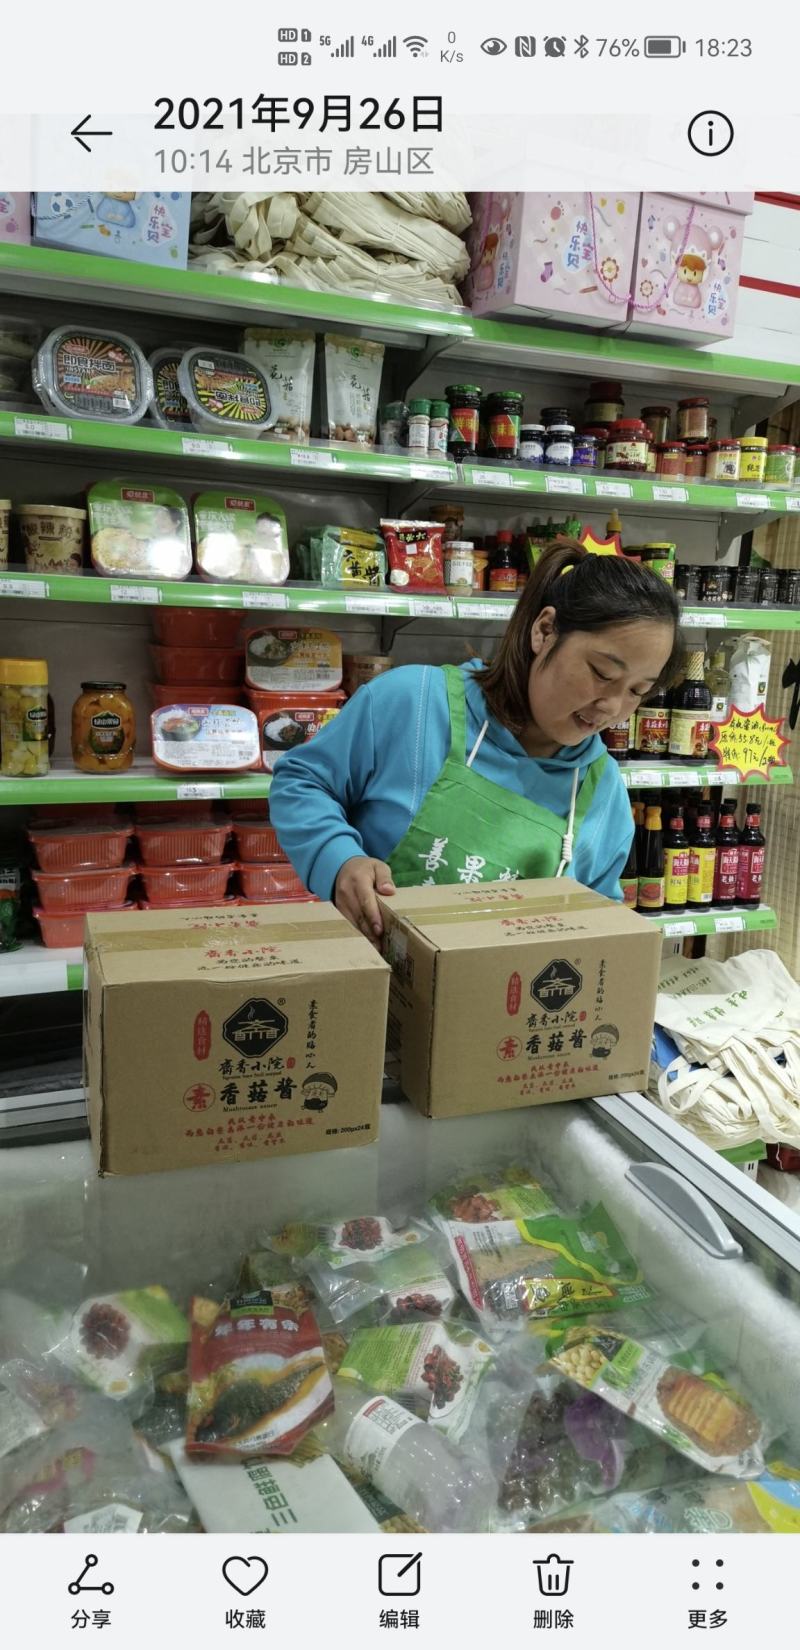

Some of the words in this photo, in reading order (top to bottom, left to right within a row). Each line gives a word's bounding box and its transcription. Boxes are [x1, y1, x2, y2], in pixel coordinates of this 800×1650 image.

[525, 1028, 587, 1055] 香菇酱
[187, 1086, 210, 1111] 素
[220, 1077, 297, 1106] 香菇酱
